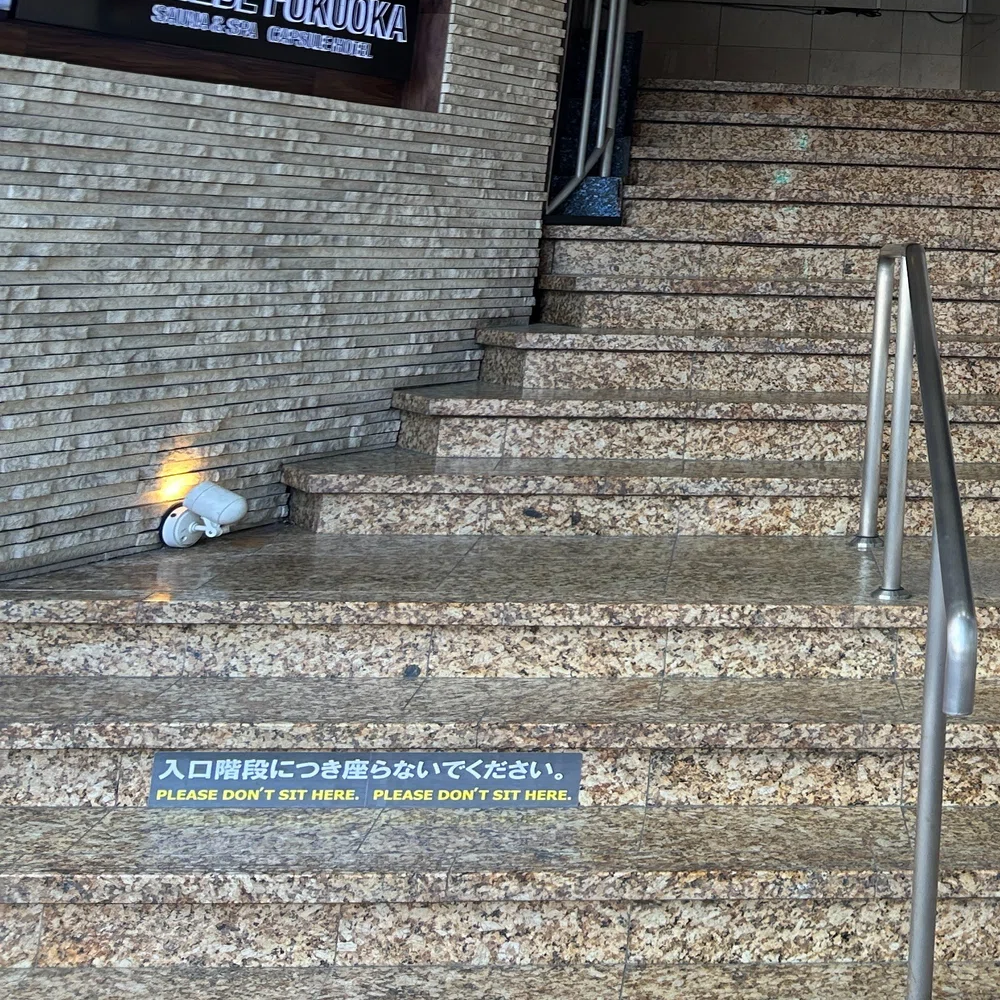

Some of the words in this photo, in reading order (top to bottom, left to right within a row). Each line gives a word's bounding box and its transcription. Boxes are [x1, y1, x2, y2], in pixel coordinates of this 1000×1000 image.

[158, 759, 563, 780] 入口階段につき座らないでください。
[156, 789, 218, 801] PLEASE
[222, 786, 275, 801] DON'T
[278, 789, 308, 801] SIT
[311, 789, 359, 801] HERE.
[373, 789, 433, 801] PLEASE
[437, 786, 490, 801] DON'T
[492, 789, 521, 801] SIT
[524, 789, 572, 801] HERE.
